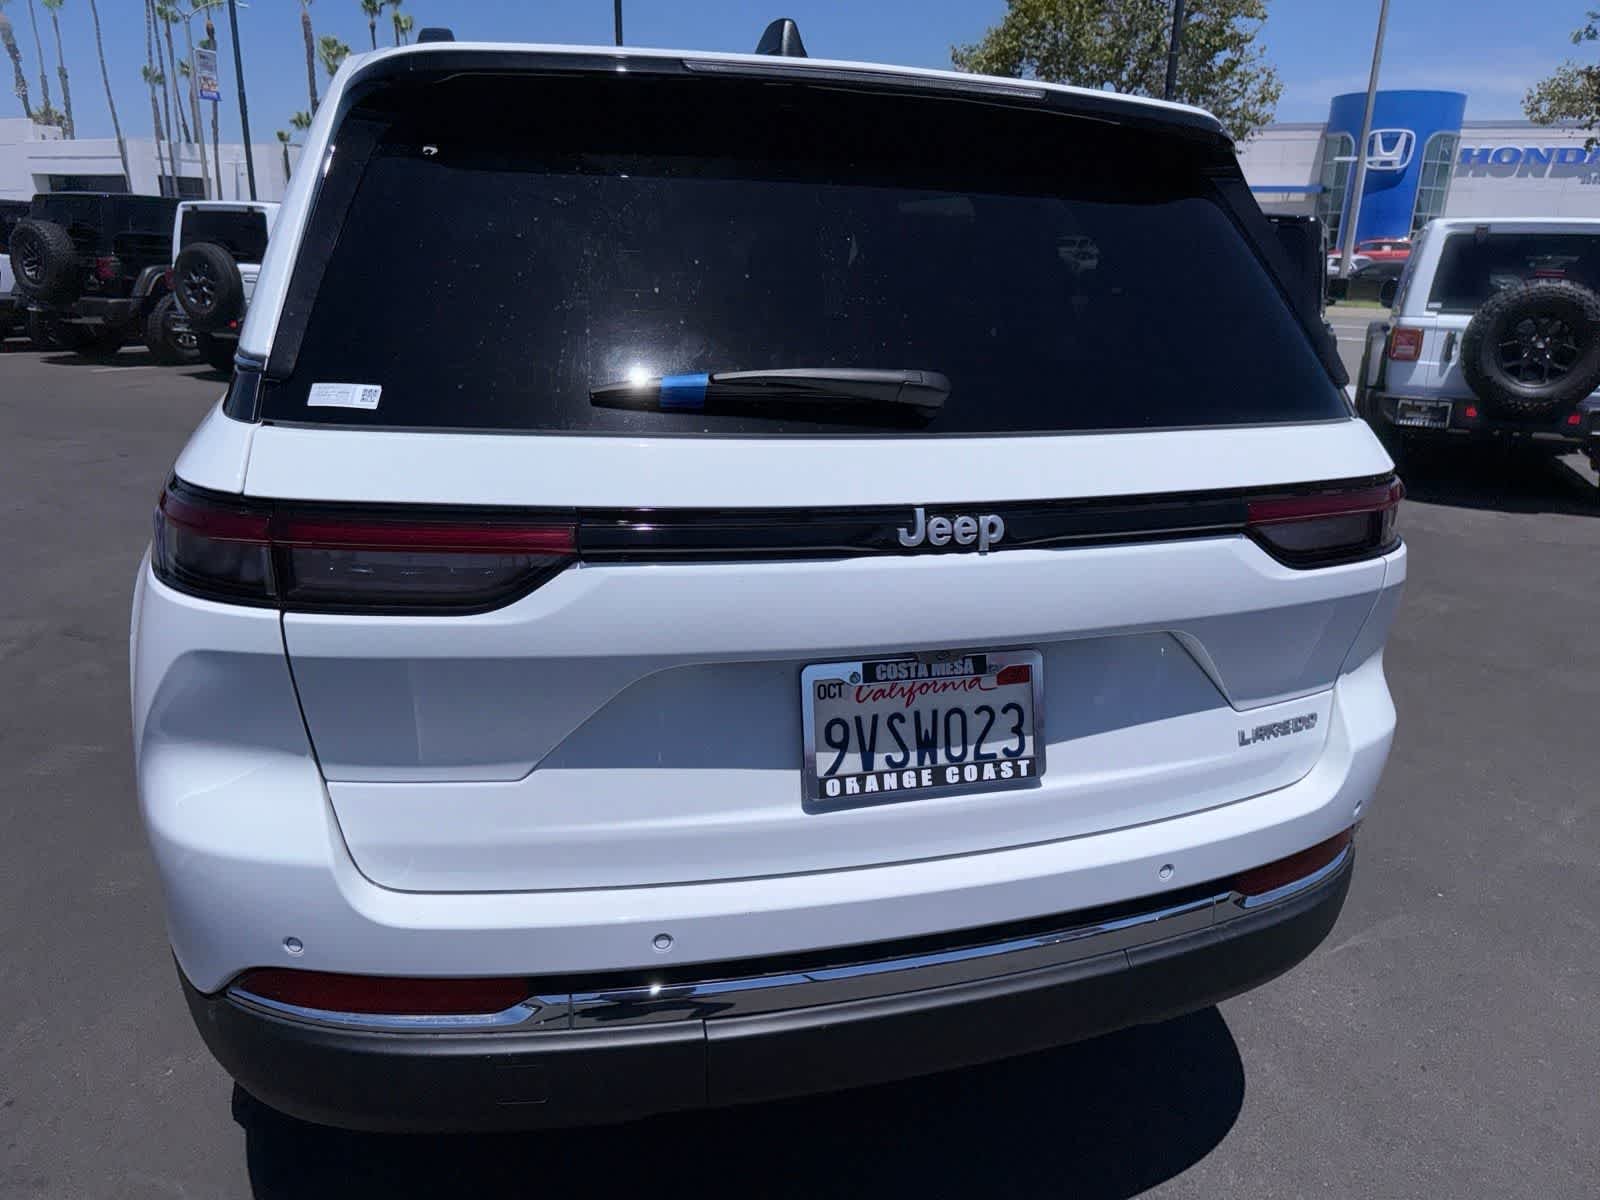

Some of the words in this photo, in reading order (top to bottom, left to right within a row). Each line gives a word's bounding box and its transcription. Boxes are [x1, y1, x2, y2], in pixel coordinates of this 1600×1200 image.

[897, 507, 1005, 551] Jeep
[875, 661, 929, 682] COSTA
[931, 656, 975, 677] MESA
[817, 684, 844, 700] OCT
[855, 676, 998, 708] California
[823, 702, 1026, 777] 9VSW023
[1238, 713, 1318, 747] LAREDO
[825, 768, 932, 797] ORANGE
[945, 759, 1030, 784] COAST
